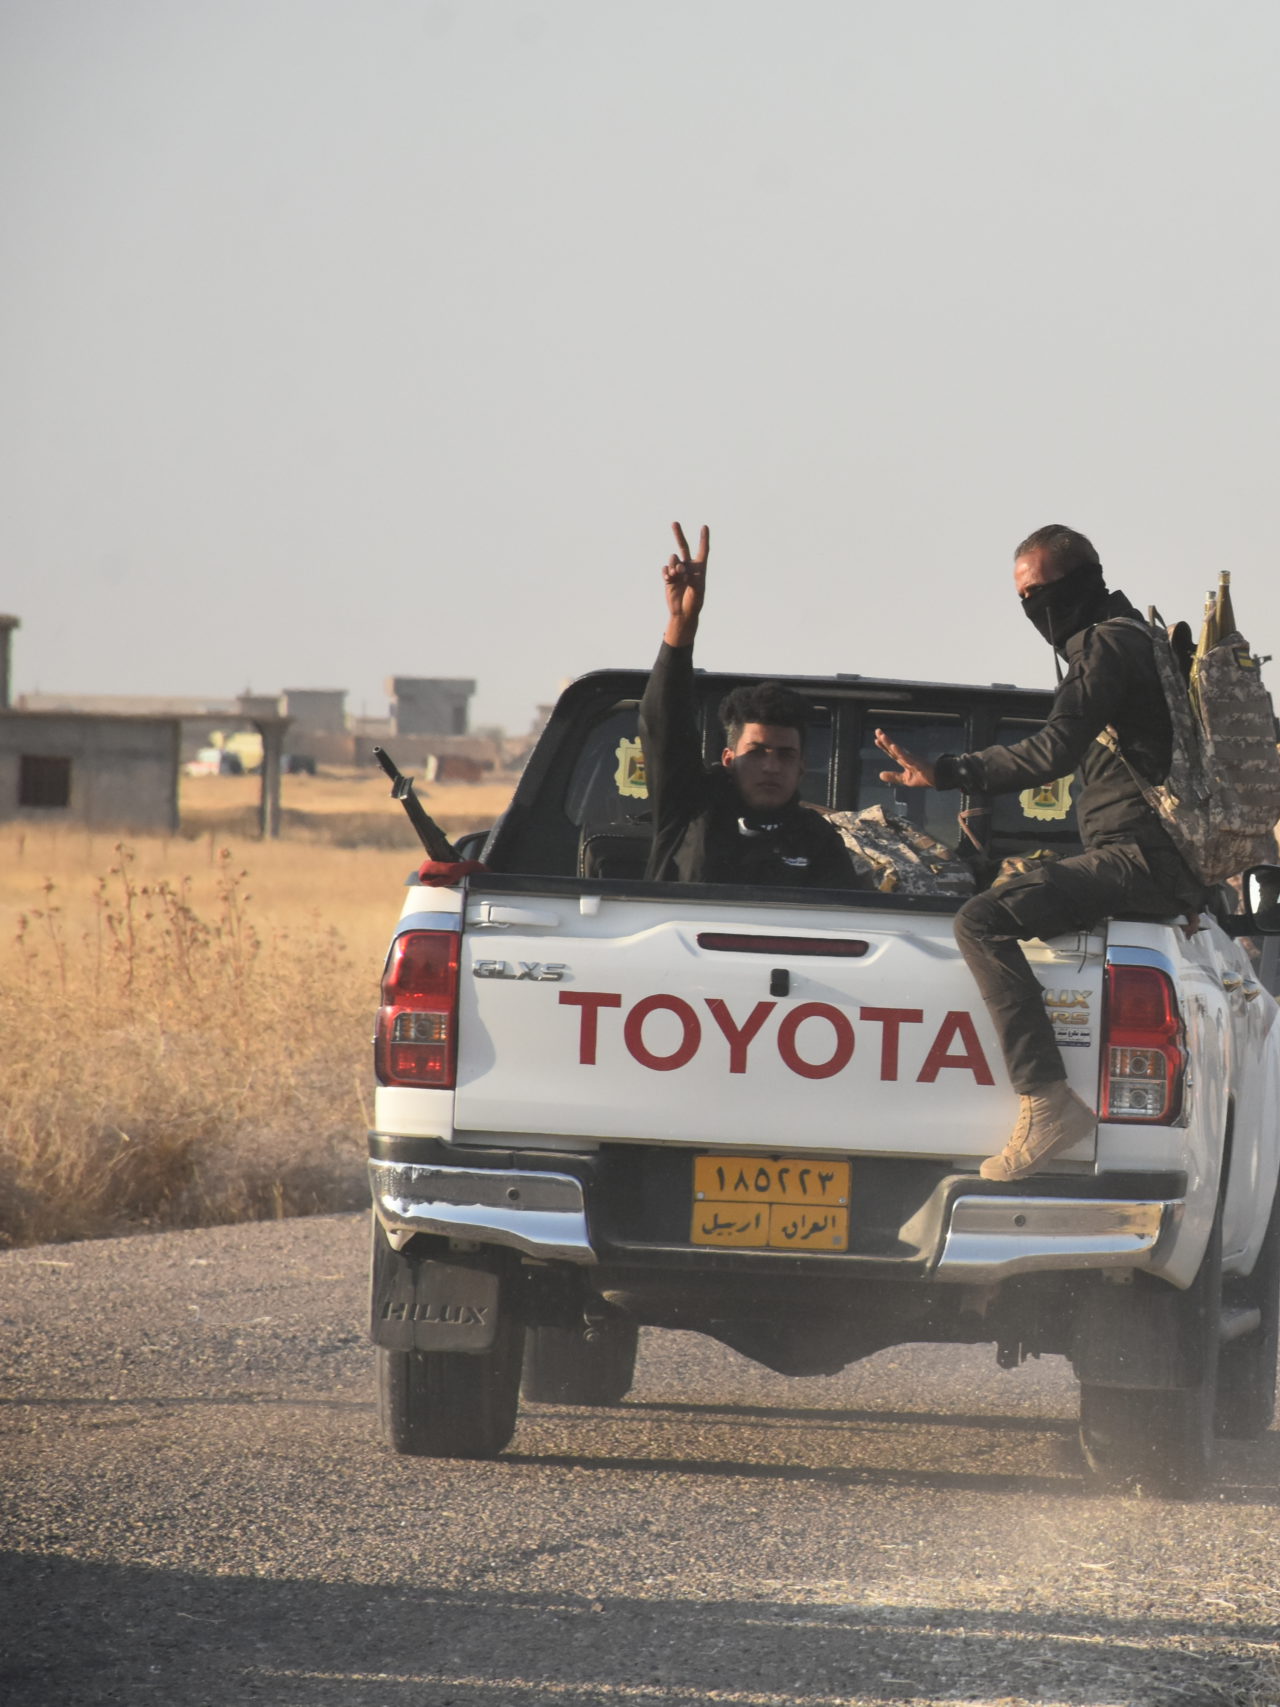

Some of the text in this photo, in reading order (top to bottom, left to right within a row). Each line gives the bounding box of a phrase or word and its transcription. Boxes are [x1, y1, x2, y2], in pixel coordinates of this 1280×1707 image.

[1044, 989, 1093, 1008] LUX
[559, 991, 996, 1086] TOYOTA
[716, 1165, 834, 1196] ١٨٥٢٢٣
[780, 1214, 836, 1240] العراق
[381, 1301, 490, 1326] HILUX
